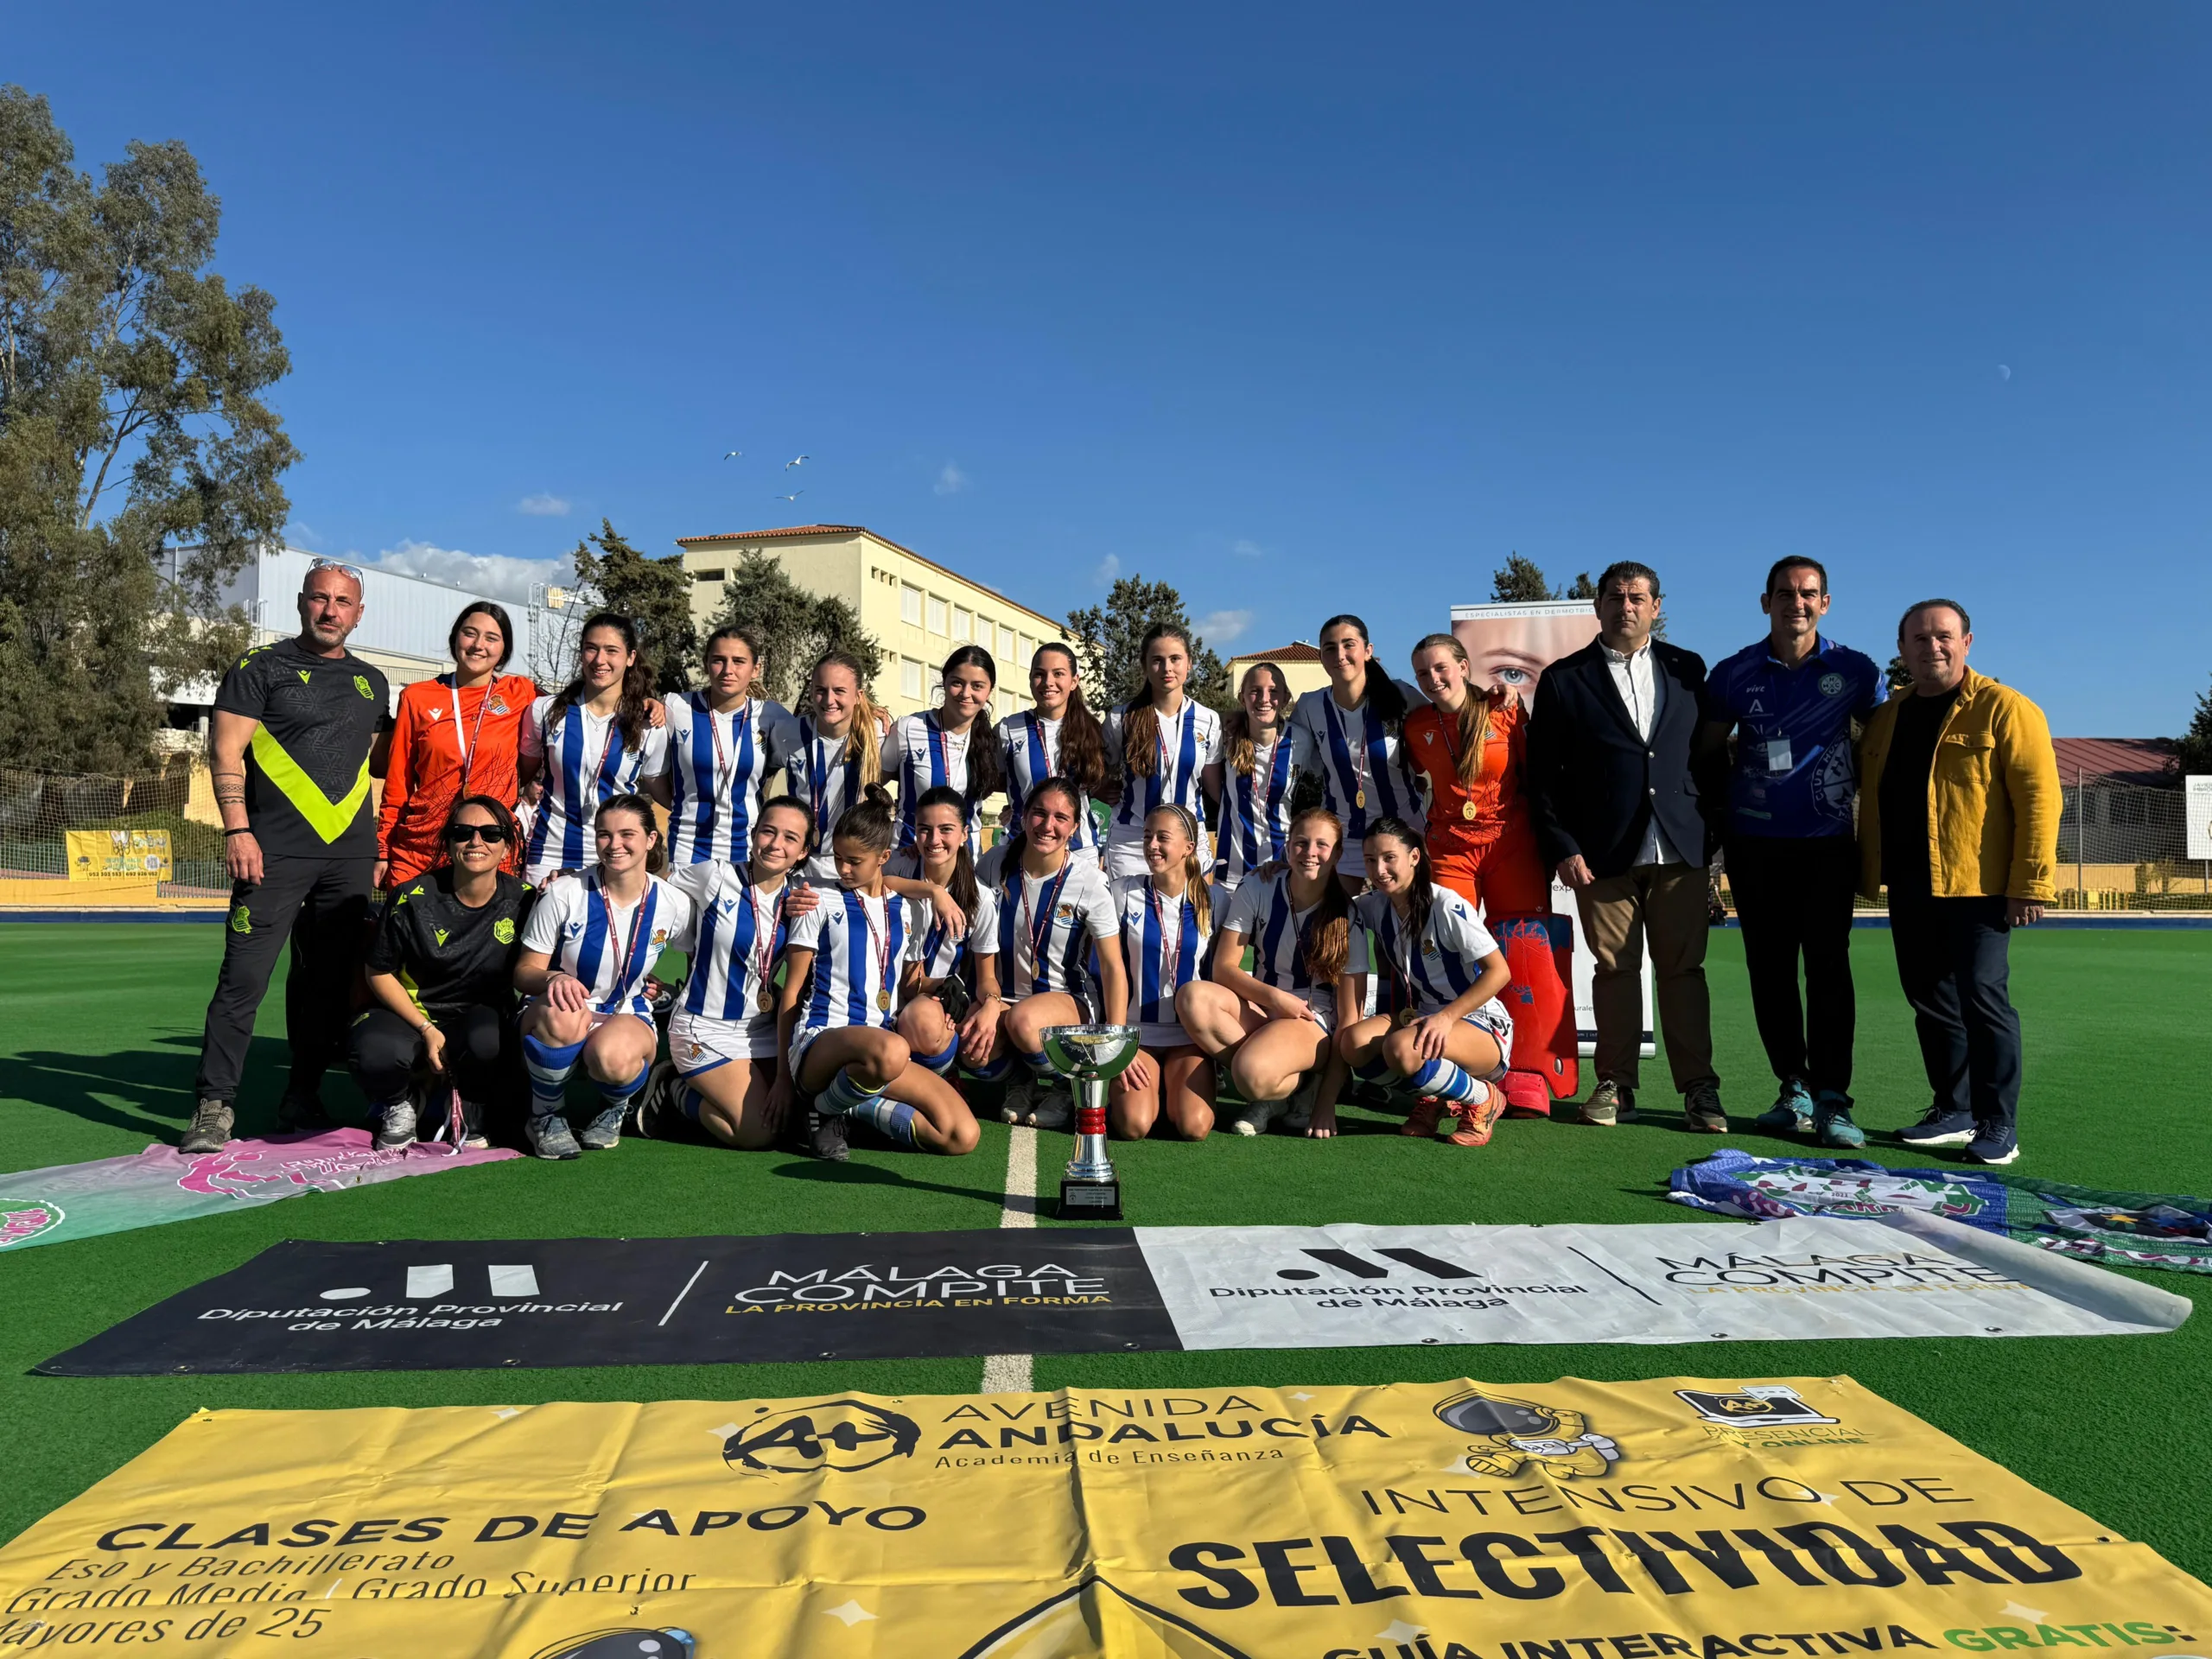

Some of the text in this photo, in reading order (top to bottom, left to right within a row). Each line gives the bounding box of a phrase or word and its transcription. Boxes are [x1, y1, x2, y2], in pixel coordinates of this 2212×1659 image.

[1465, 610, 1527, 619] ESPECIALISTAS
[1552, 884, 1573, 893] exp
[1656, 1252, 1955, 1269] MÁLAGA
[768, 1263, 1079, 1286] MÁLAGA
[1666, 1266, 2021, 1285] COMPITE
[734, 1278, 1110, 1303] COMPITE
[1210, 1283, 1588, 1298] Diputación Provincial
[1686, 1286, 1730, 1294] LA
[1732, 1284, 1890, 1294] PROVINCIA
[1896, 1284, 1932, 1293] EN
[197, 1300, 624, 1320] Diputación Provincial
[724, 1294, 1114, 1314] LA PROVINCIA EN FORMA
[1317, 1295, 1510, 1310] de Málaga
[287, 1316, 500, 1333] de Málaga
[941, 1395, 1264, 1423] AVENIDA
[938, 1414, 1393, 1449] ANDALUCÍA
[1702, 1426, 1875, 1440] PRESENCIAL
[1732, 1437, 1870, 1448] Y ONLINE
[935, 1447, 1285, 1469] Academia de Enseñanza
[1361, 1476, 1976, 1516] INTENSIVO DE
[96, 1500, 927, 1552] CLASES DE APOYO
[45, 1551, 455, 1580] Eso y Bachillerato
[1168, 1521, 2083, 1610] SELECTIVIDAD
[5, 1582, 151, 1614] Grado
[166, 1580, 308, 1605] Medio
[351, 1573, 487, 1599] Grado
[503, 1567, 697, 1599] Superior
[184, 1610, 247, 1640] de
[256, 1607, 332, 1638] 25
[1499, 1624, 1941, 1659] INTERACTIVA
[1943, 1621, 2198, 1652] GRATIS:
